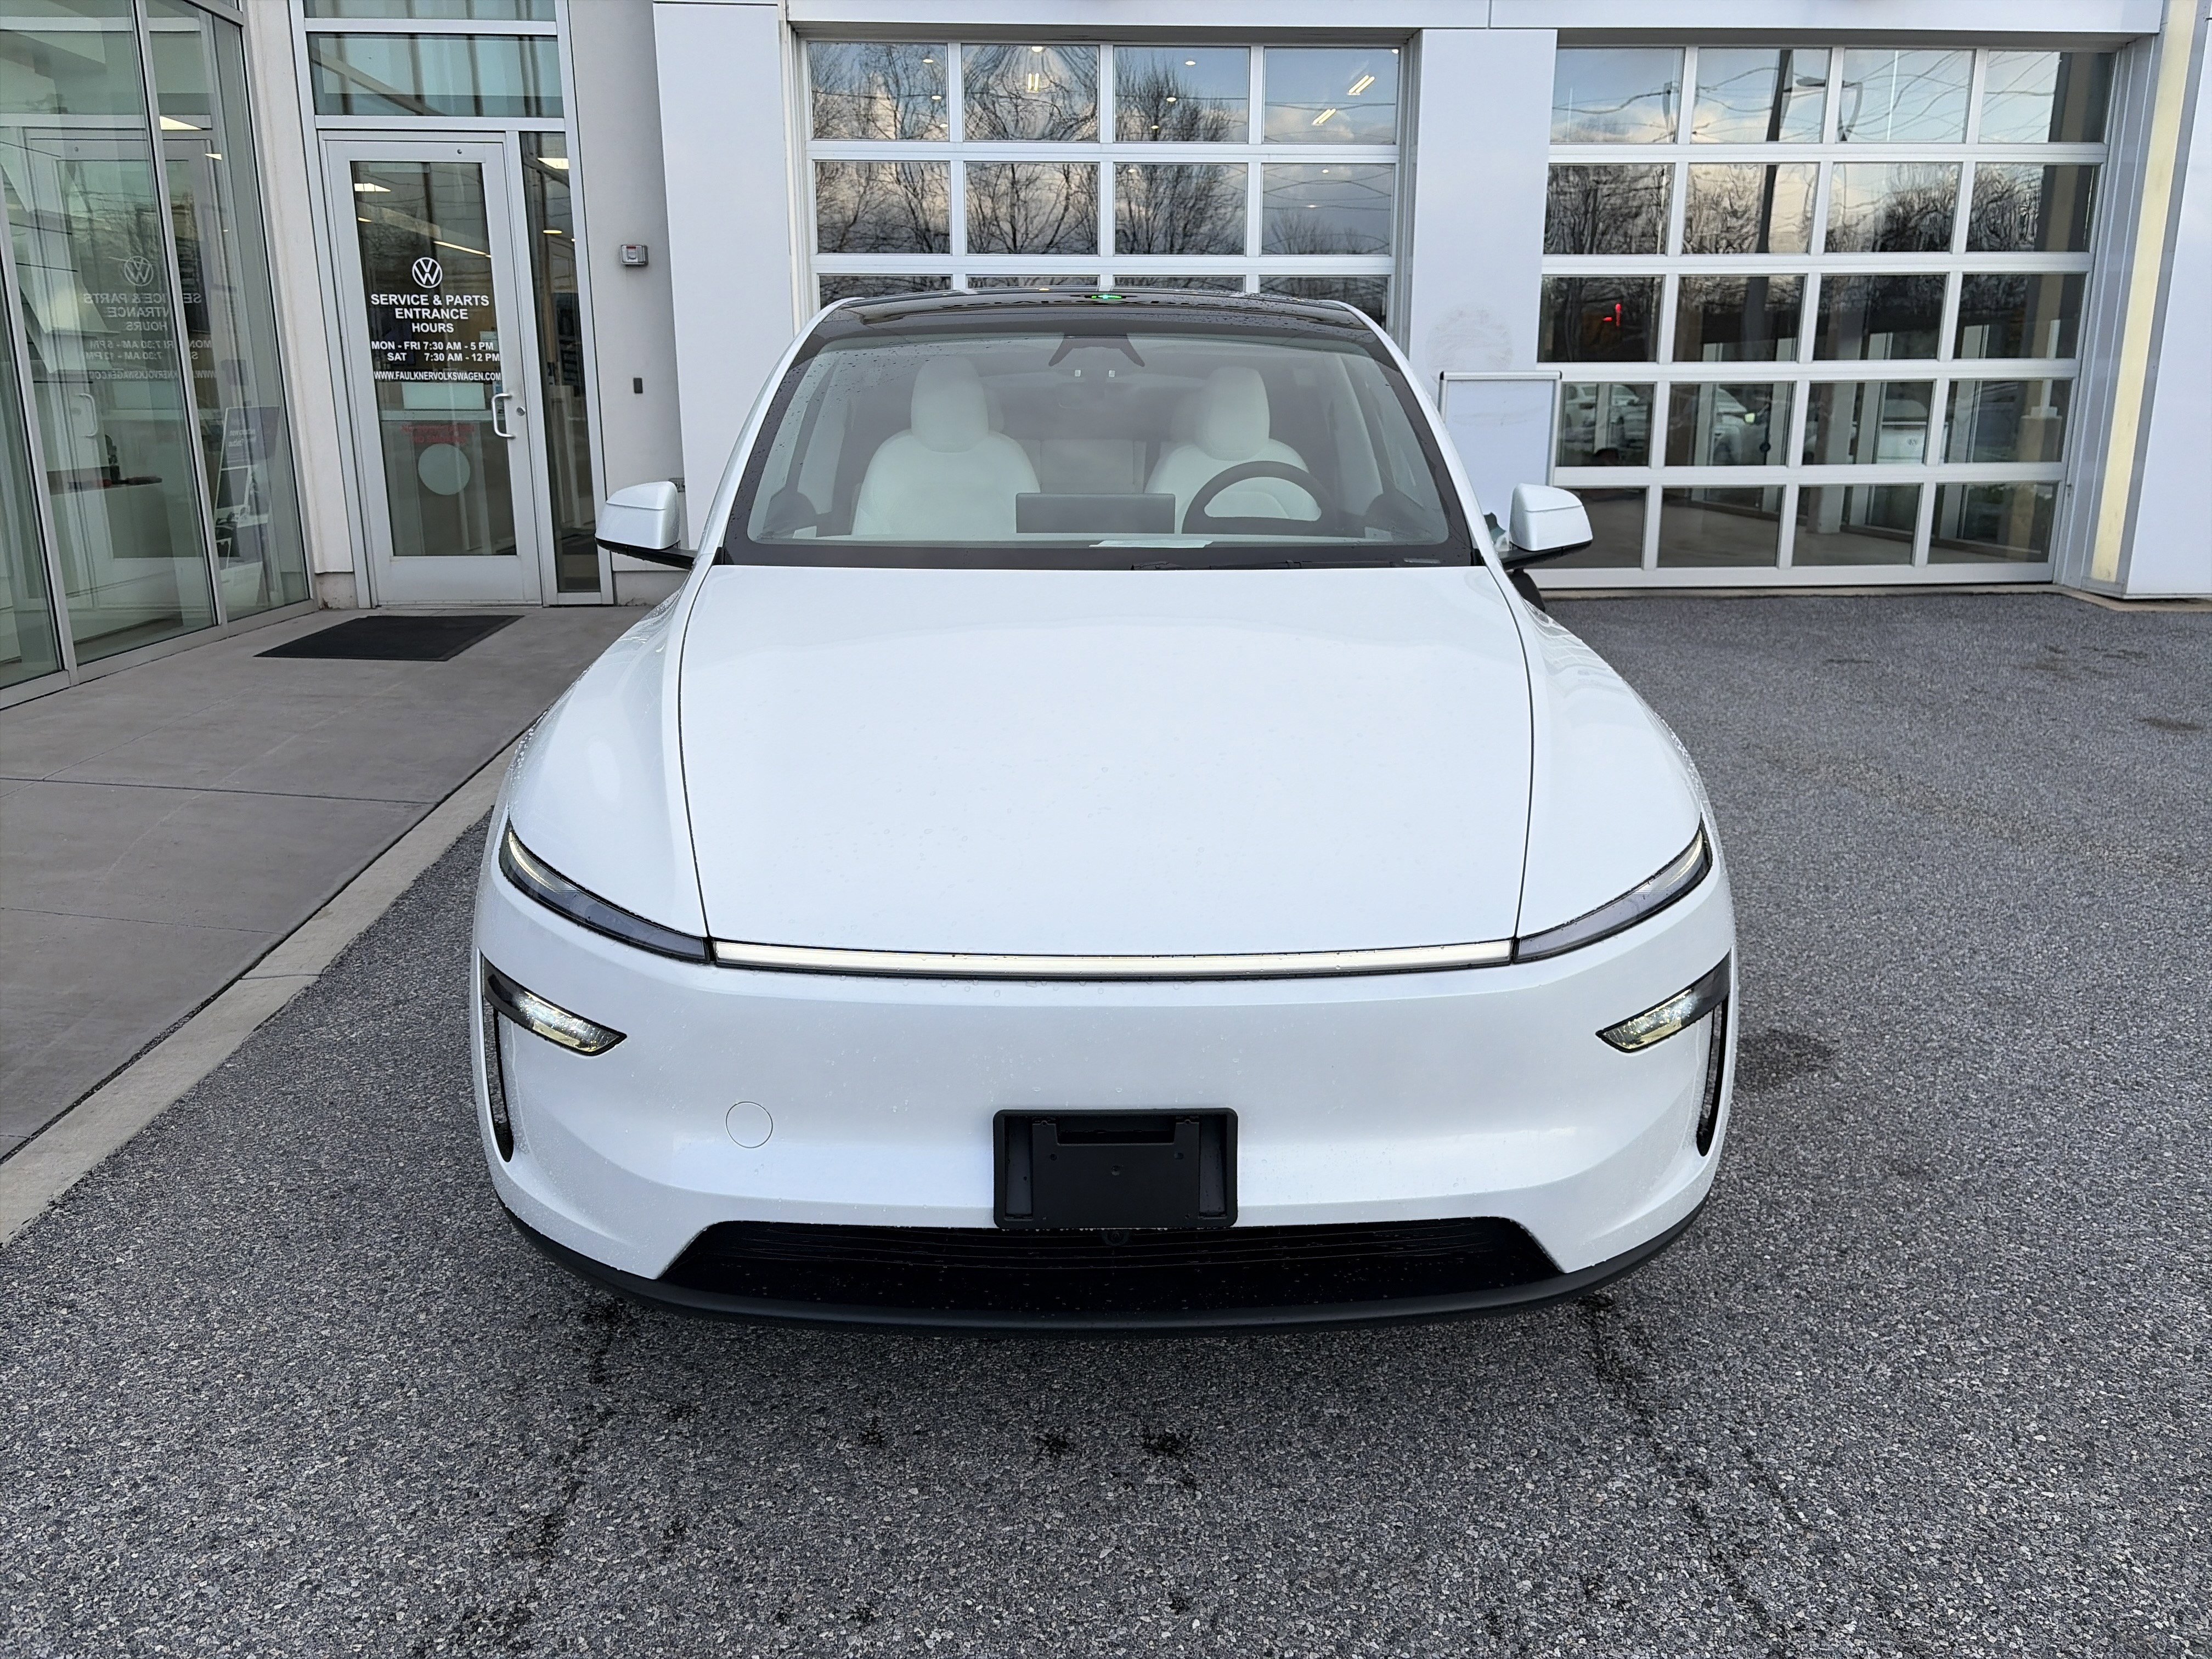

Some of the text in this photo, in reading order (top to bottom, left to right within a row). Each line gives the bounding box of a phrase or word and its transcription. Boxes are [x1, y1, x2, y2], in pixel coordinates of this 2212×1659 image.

[371, 294, 489, 306] SERVICE & PARTS
[395, 308, 469, 320] ENTRANCE
[412, 323, 454, 333] HOURS
[371, 341, 395, 350] MON
[404, 341, 420, 351] FRI
[424, 341, 444, 351] 7:30
[445, 342, 461, 351] AM
[470, 342, 476, 351] 5
[478, 342, 494, 351] PM
[387, 353, 407, 361] SAT
[425, 353, 444, 362] 7:30
[447, 353, 462, 362] AM
[472, 353, 482, 362] 12
[486, 353, 500, 362] PM
[374, 371, 501, 381] WWW.FAULKNERVOLKSWAGEN.COM
